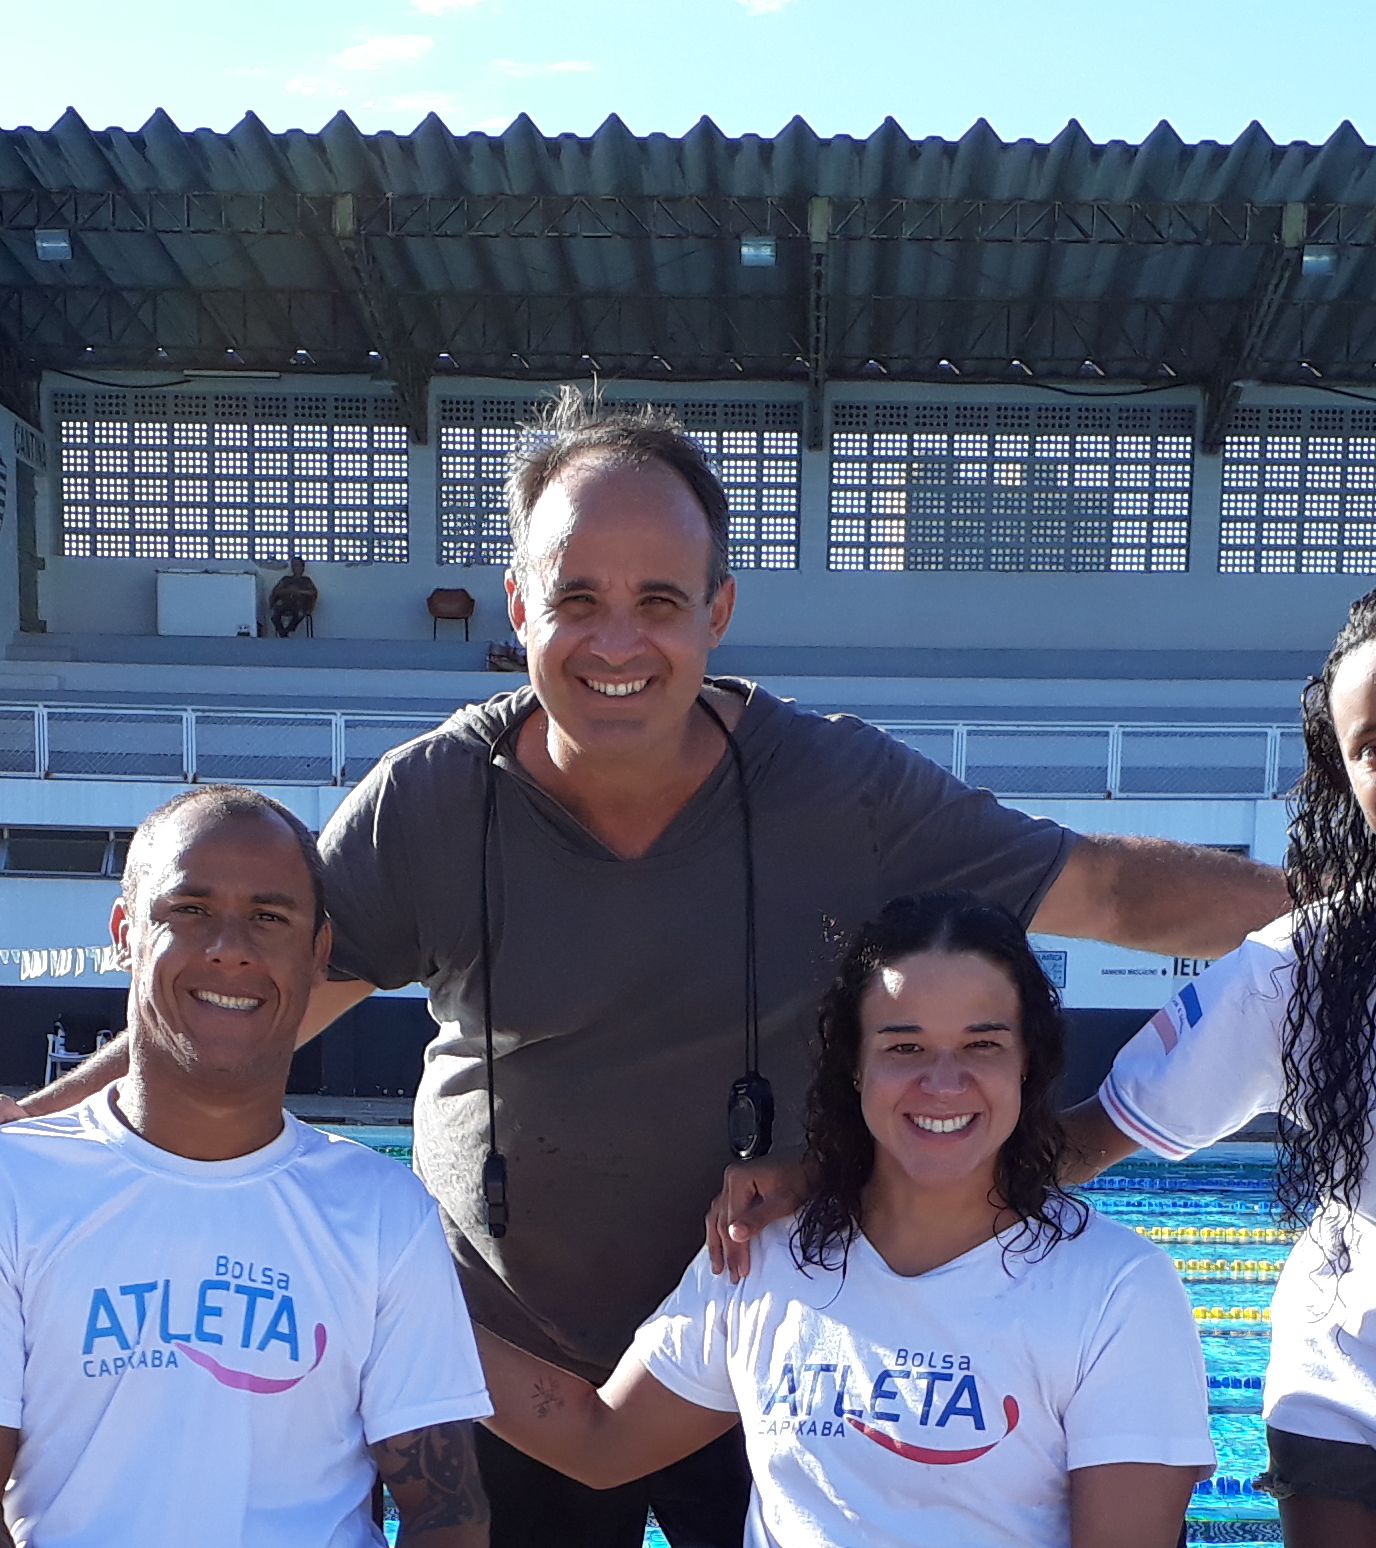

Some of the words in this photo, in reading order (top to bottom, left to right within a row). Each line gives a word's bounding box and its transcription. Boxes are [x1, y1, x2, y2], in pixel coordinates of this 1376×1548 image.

[215, 1255, 290, 1291] Bolsa
[82, 1278, 299, 1362] ATLETA
[83, 1349, 179, 1378] CAPXABA
[894, 1348, 971, 1371] Bolsa
[762, 1363, 986, 1431] ATLETA
